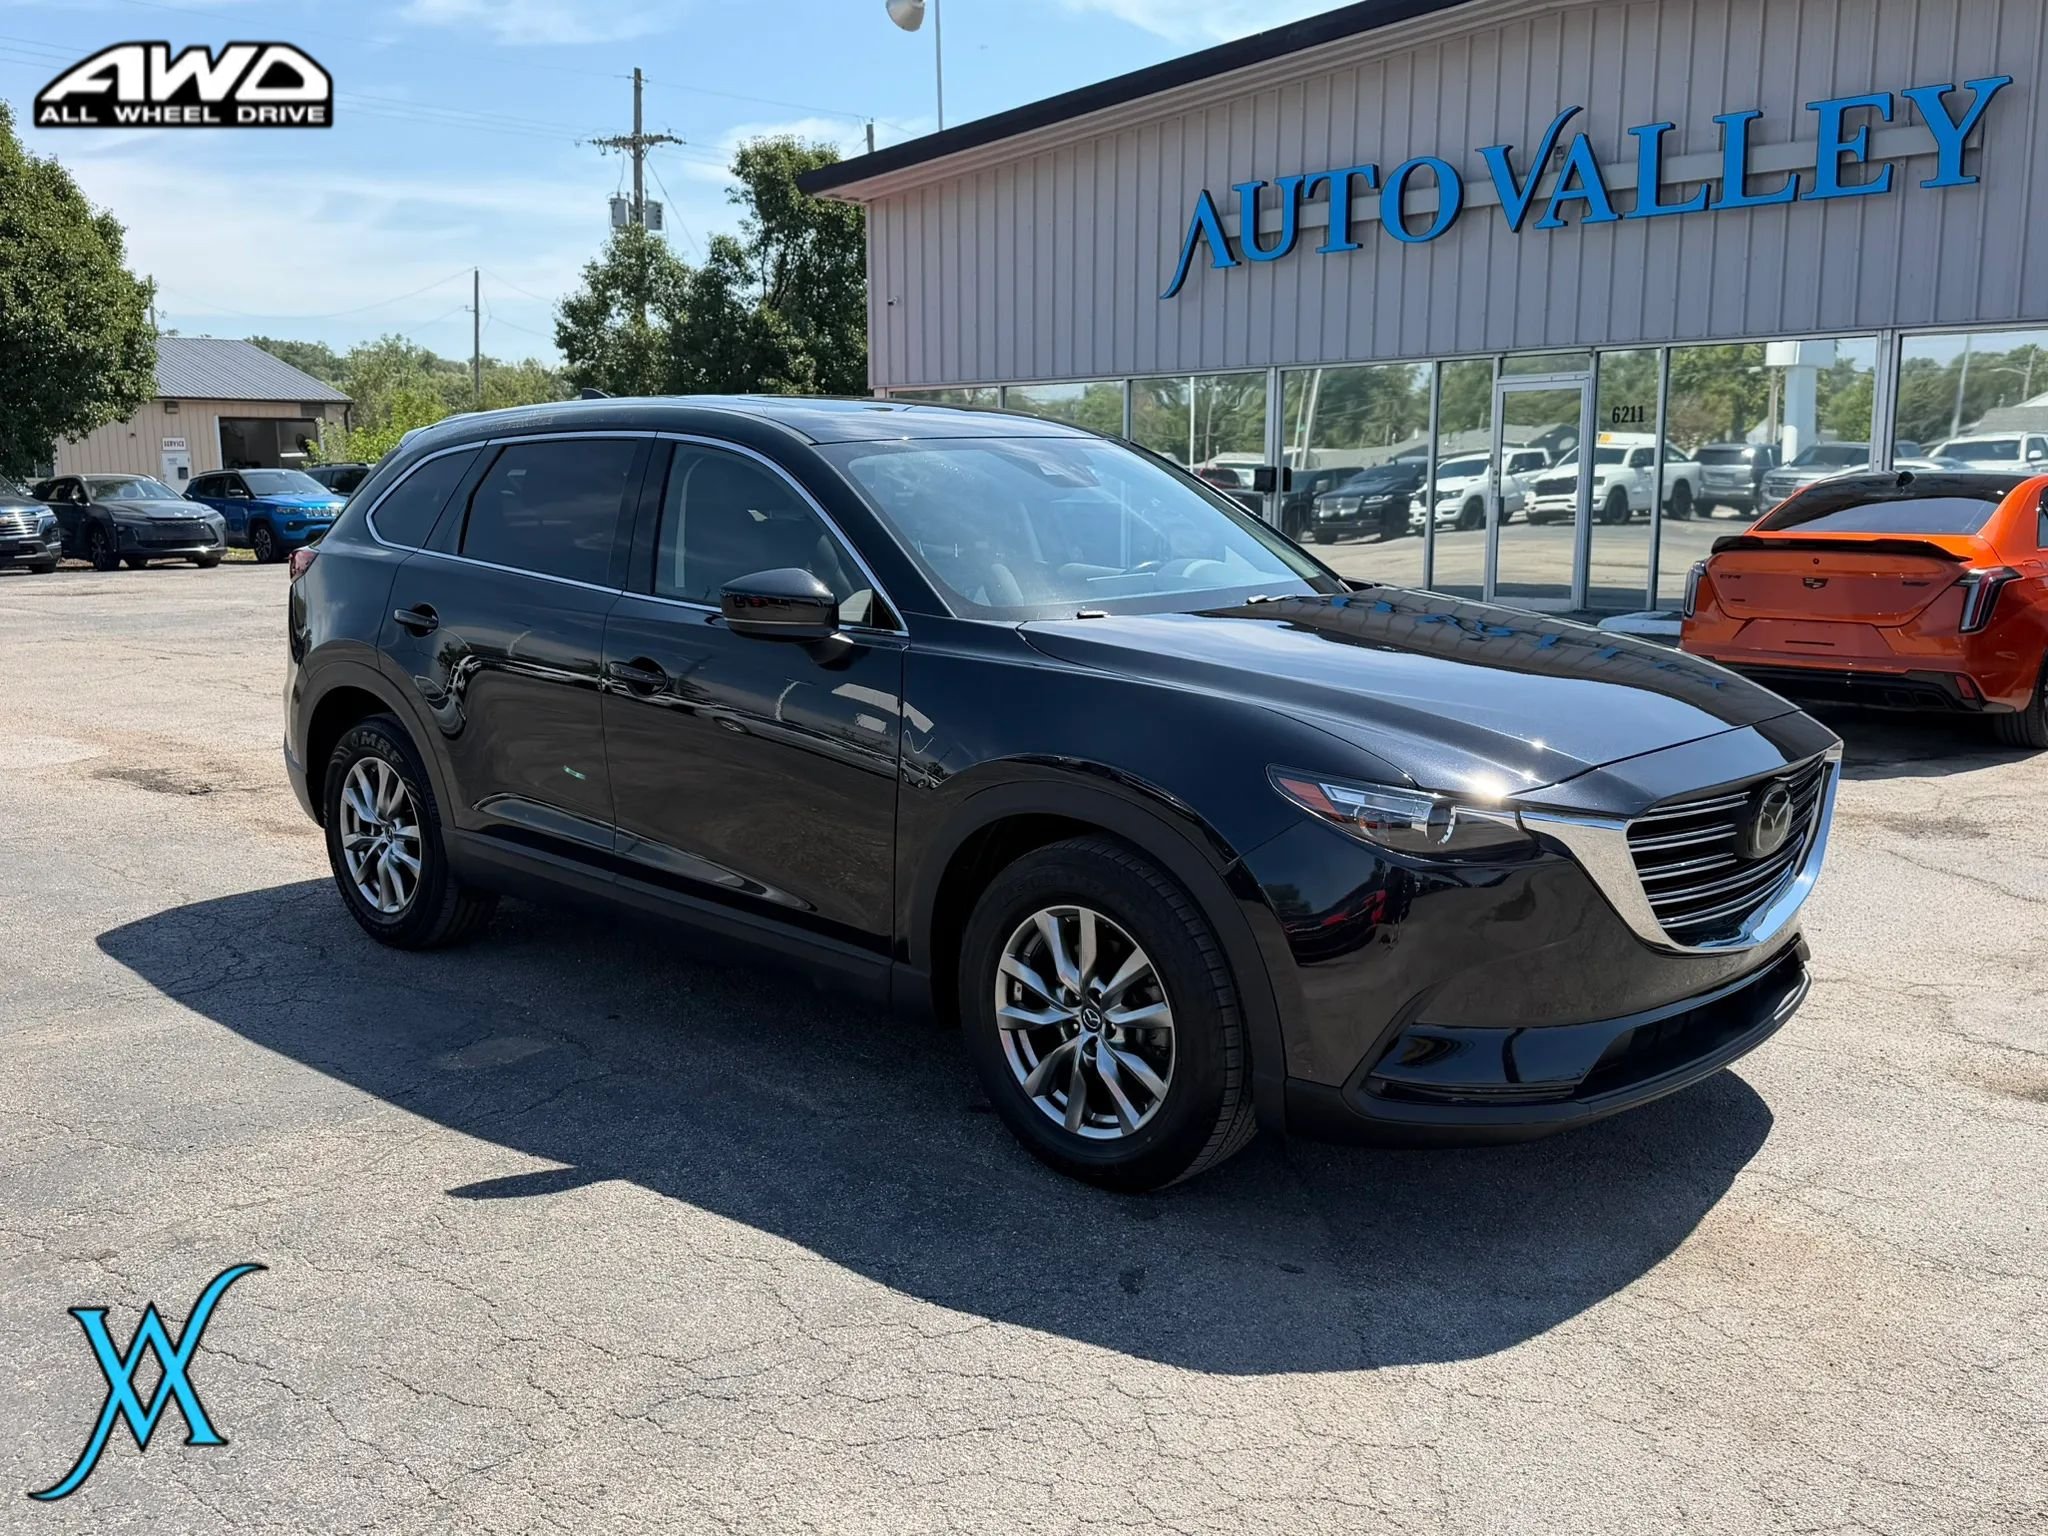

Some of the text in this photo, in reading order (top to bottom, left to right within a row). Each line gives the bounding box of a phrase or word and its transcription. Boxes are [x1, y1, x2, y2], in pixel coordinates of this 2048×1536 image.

[1160, 75, 2013, 299] AUTO VALLEY
[1612, 405, 1644, 424] 6211
[163, 440, 185, 448] SERVICE
